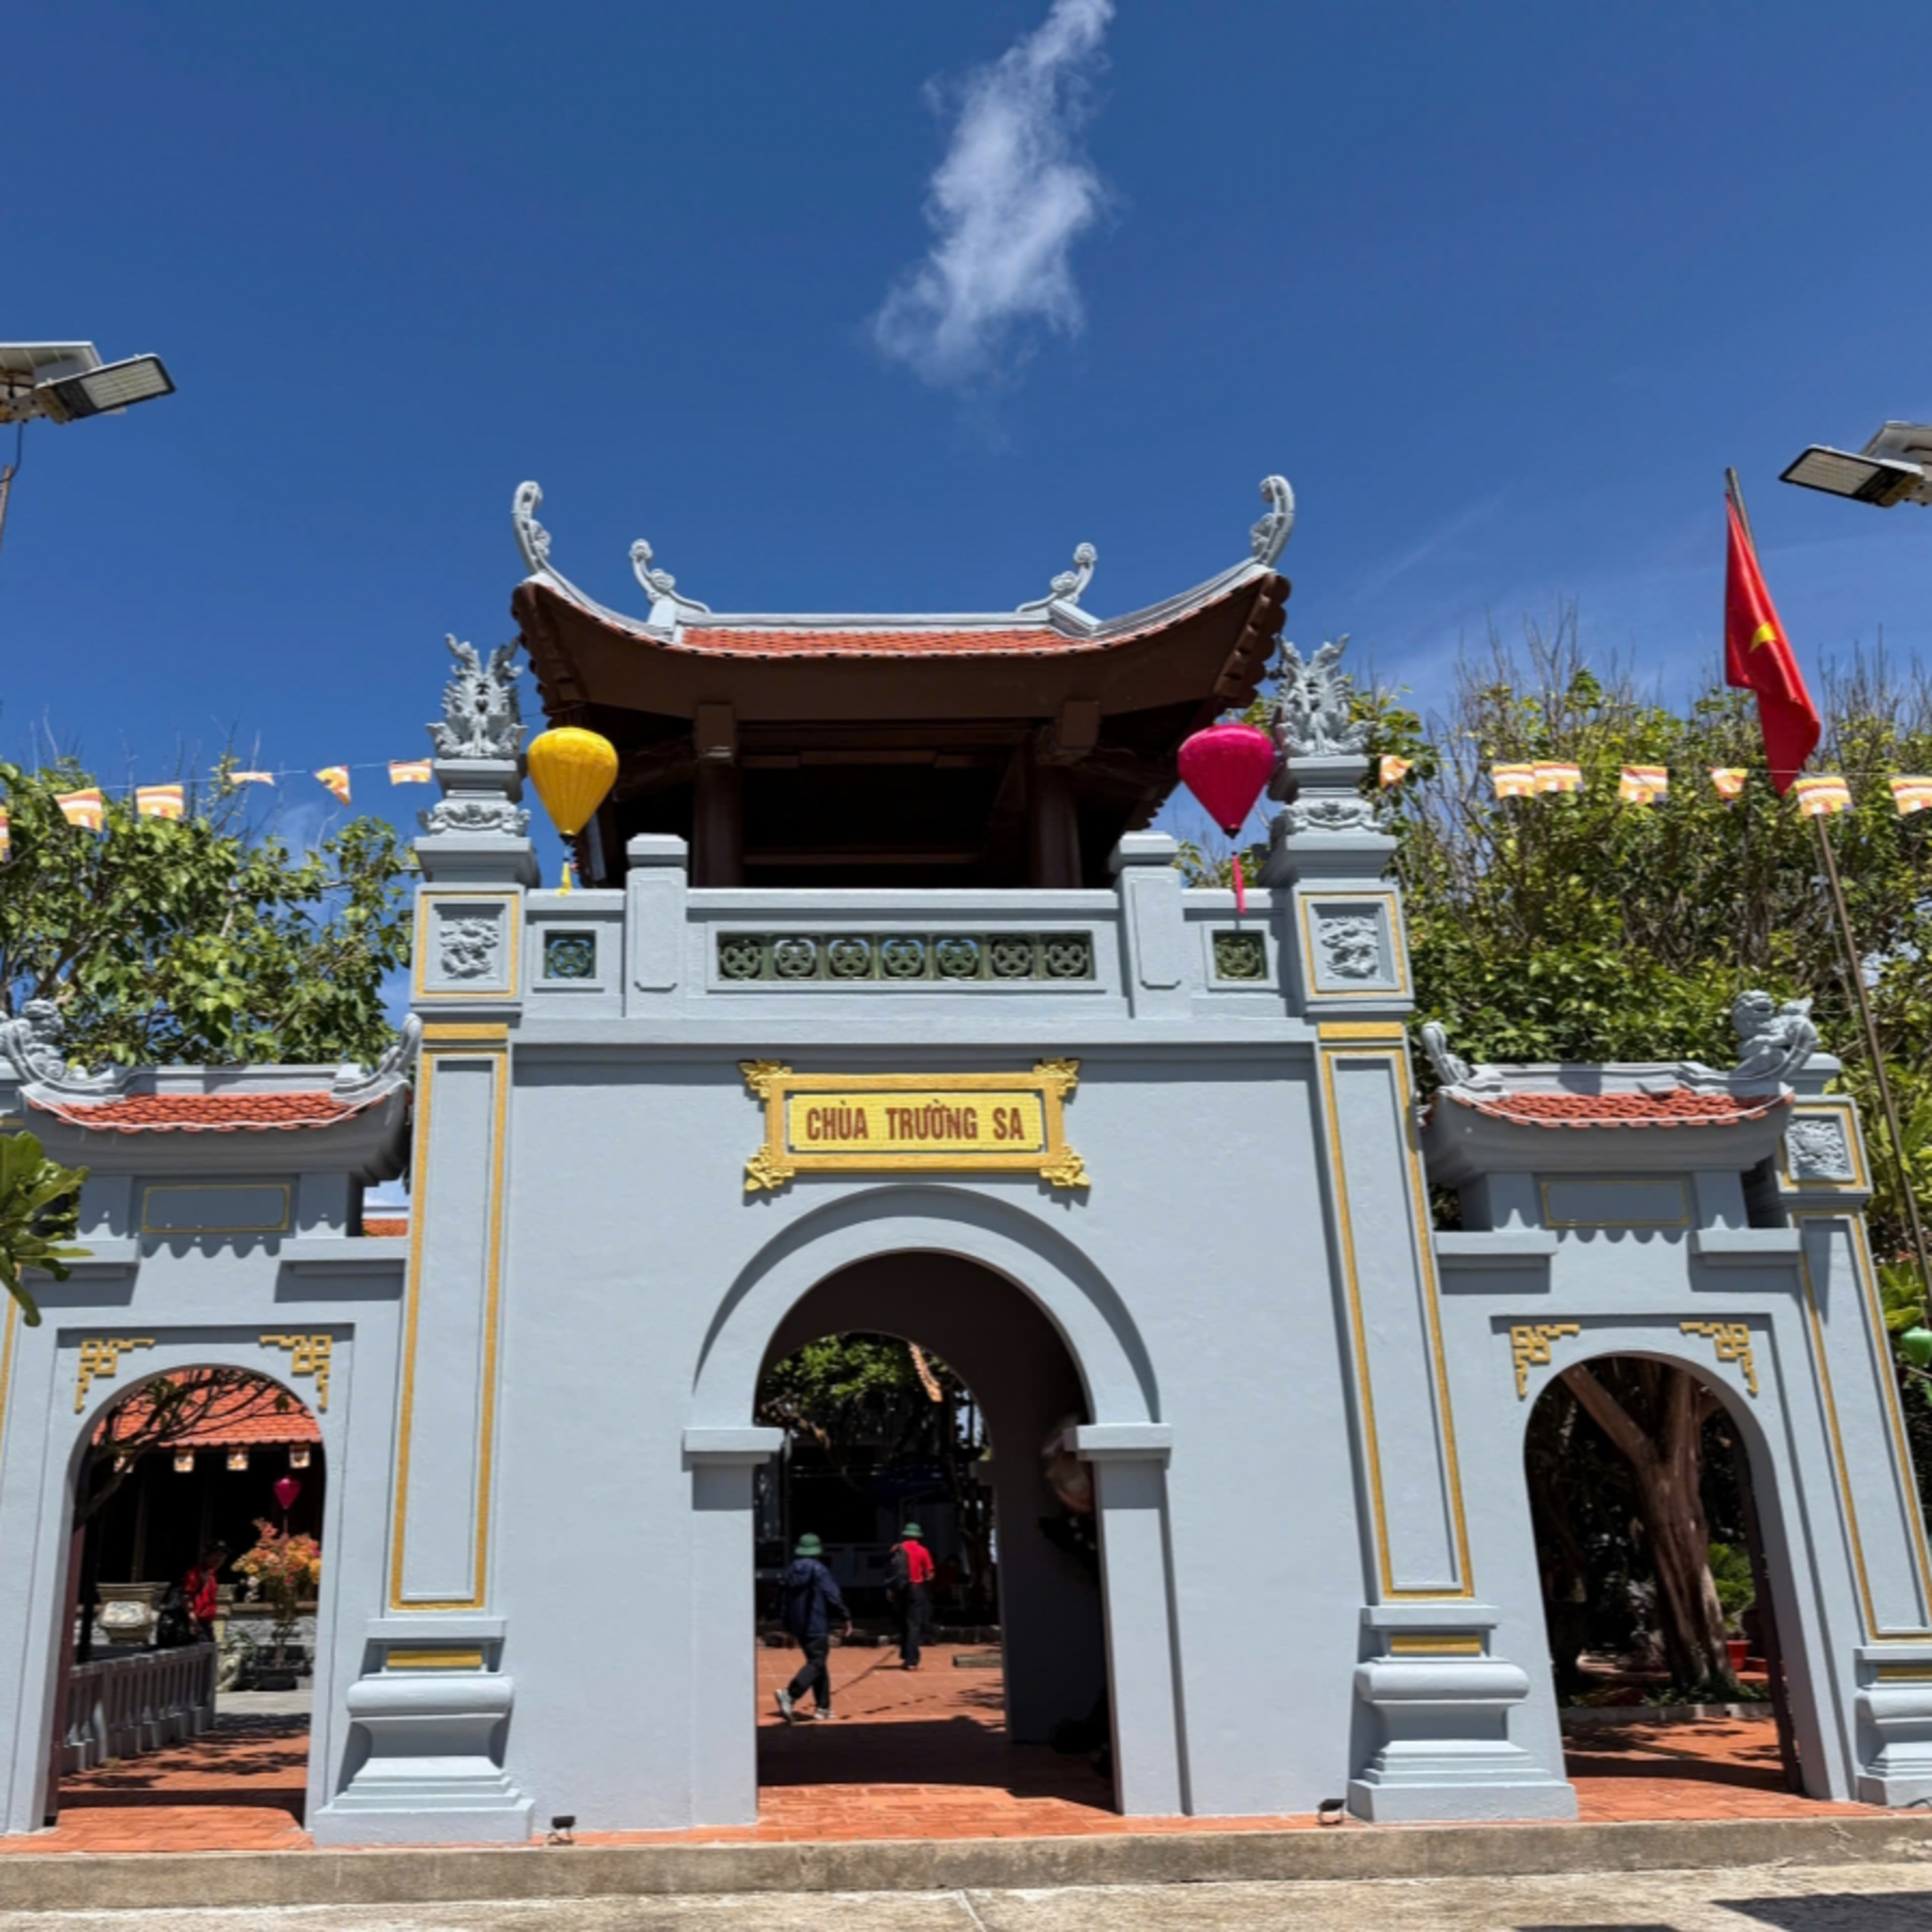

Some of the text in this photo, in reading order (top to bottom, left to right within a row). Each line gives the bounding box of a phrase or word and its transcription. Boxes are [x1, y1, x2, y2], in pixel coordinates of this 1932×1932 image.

[806, 1099, 1025, 1140] CHÙA TRƯỜNG SA
